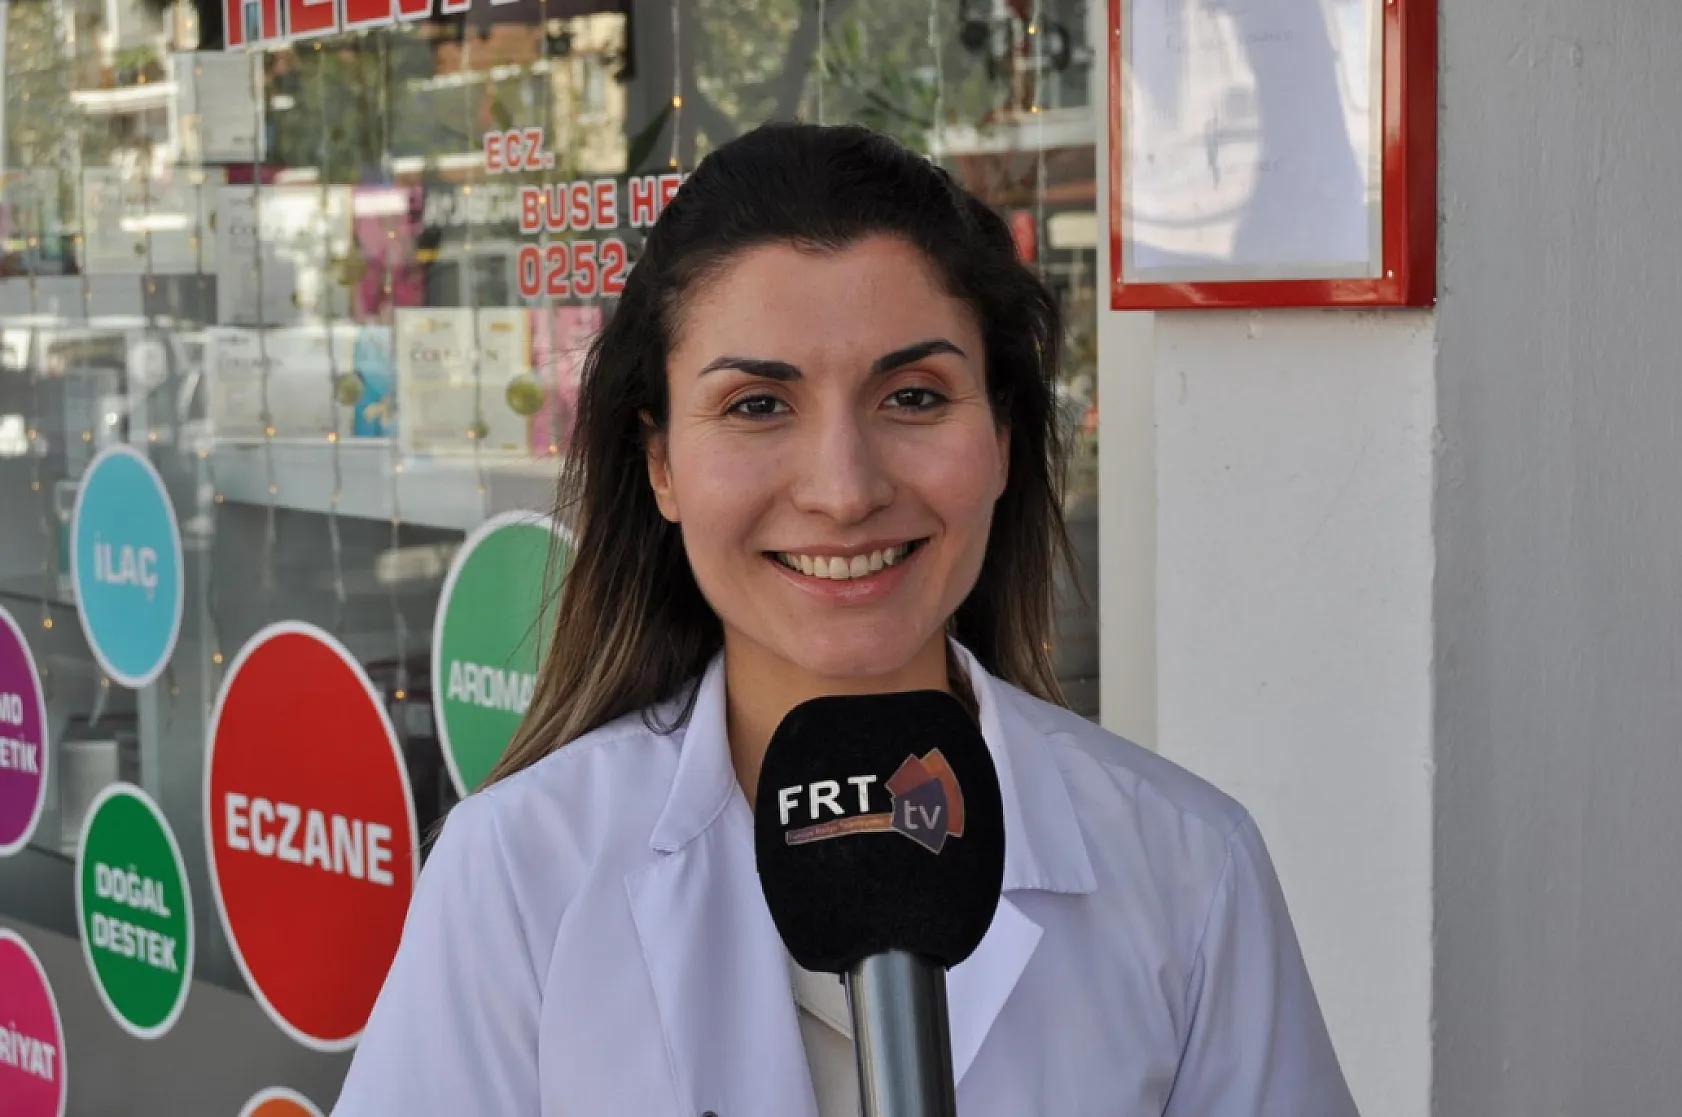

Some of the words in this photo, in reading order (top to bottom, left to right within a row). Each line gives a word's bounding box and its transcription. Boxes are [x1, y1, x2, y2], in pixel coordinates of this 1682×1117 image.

[484, 127, 555, 173] ECZ.
[519, 179, 618, 233] BUSE
[628, 174, 692, 228] HE
[517, 239, 627, 298] 0252
[94, 531, 159, 601] İLAÇ
[447, 659, 537, 714] AROMA
[778, 774, 877, 825] FRT
[904, 800, 941, 830] tv
[225, 792, 394, 886] ECZANE
[95, 862, 171, 918] DOĞAL
[92, 912, 178, 973] DESTEK
